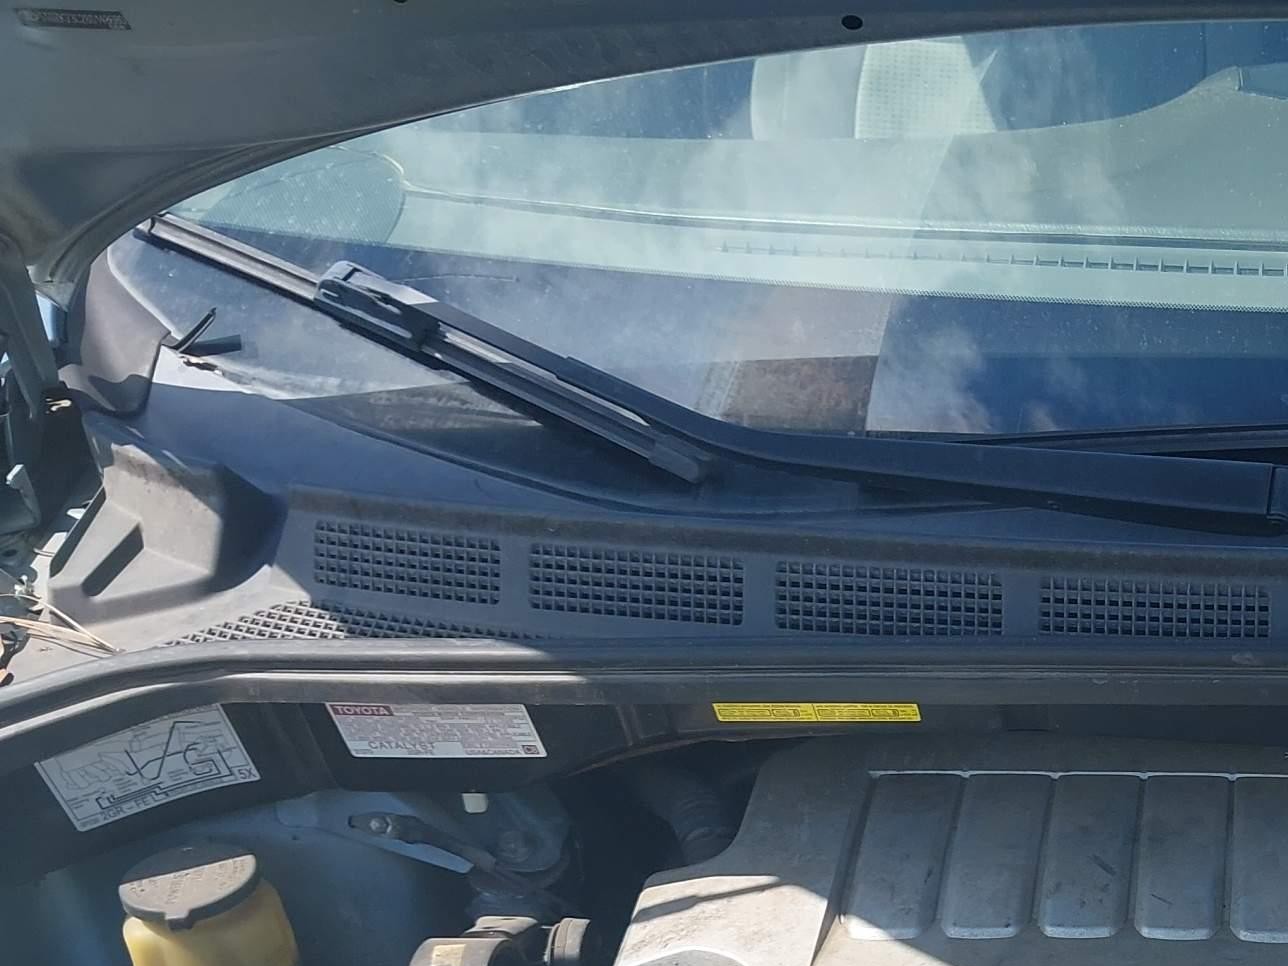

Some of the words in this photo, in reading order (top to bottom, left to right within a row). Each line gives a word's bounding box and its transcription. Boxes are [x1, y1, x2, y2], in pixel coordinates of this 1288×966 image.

[334, 705, 388, 715] TOYOTA
[368, 741, 435, 751] CATALYST
[238, 768, 257, 780] 5X
